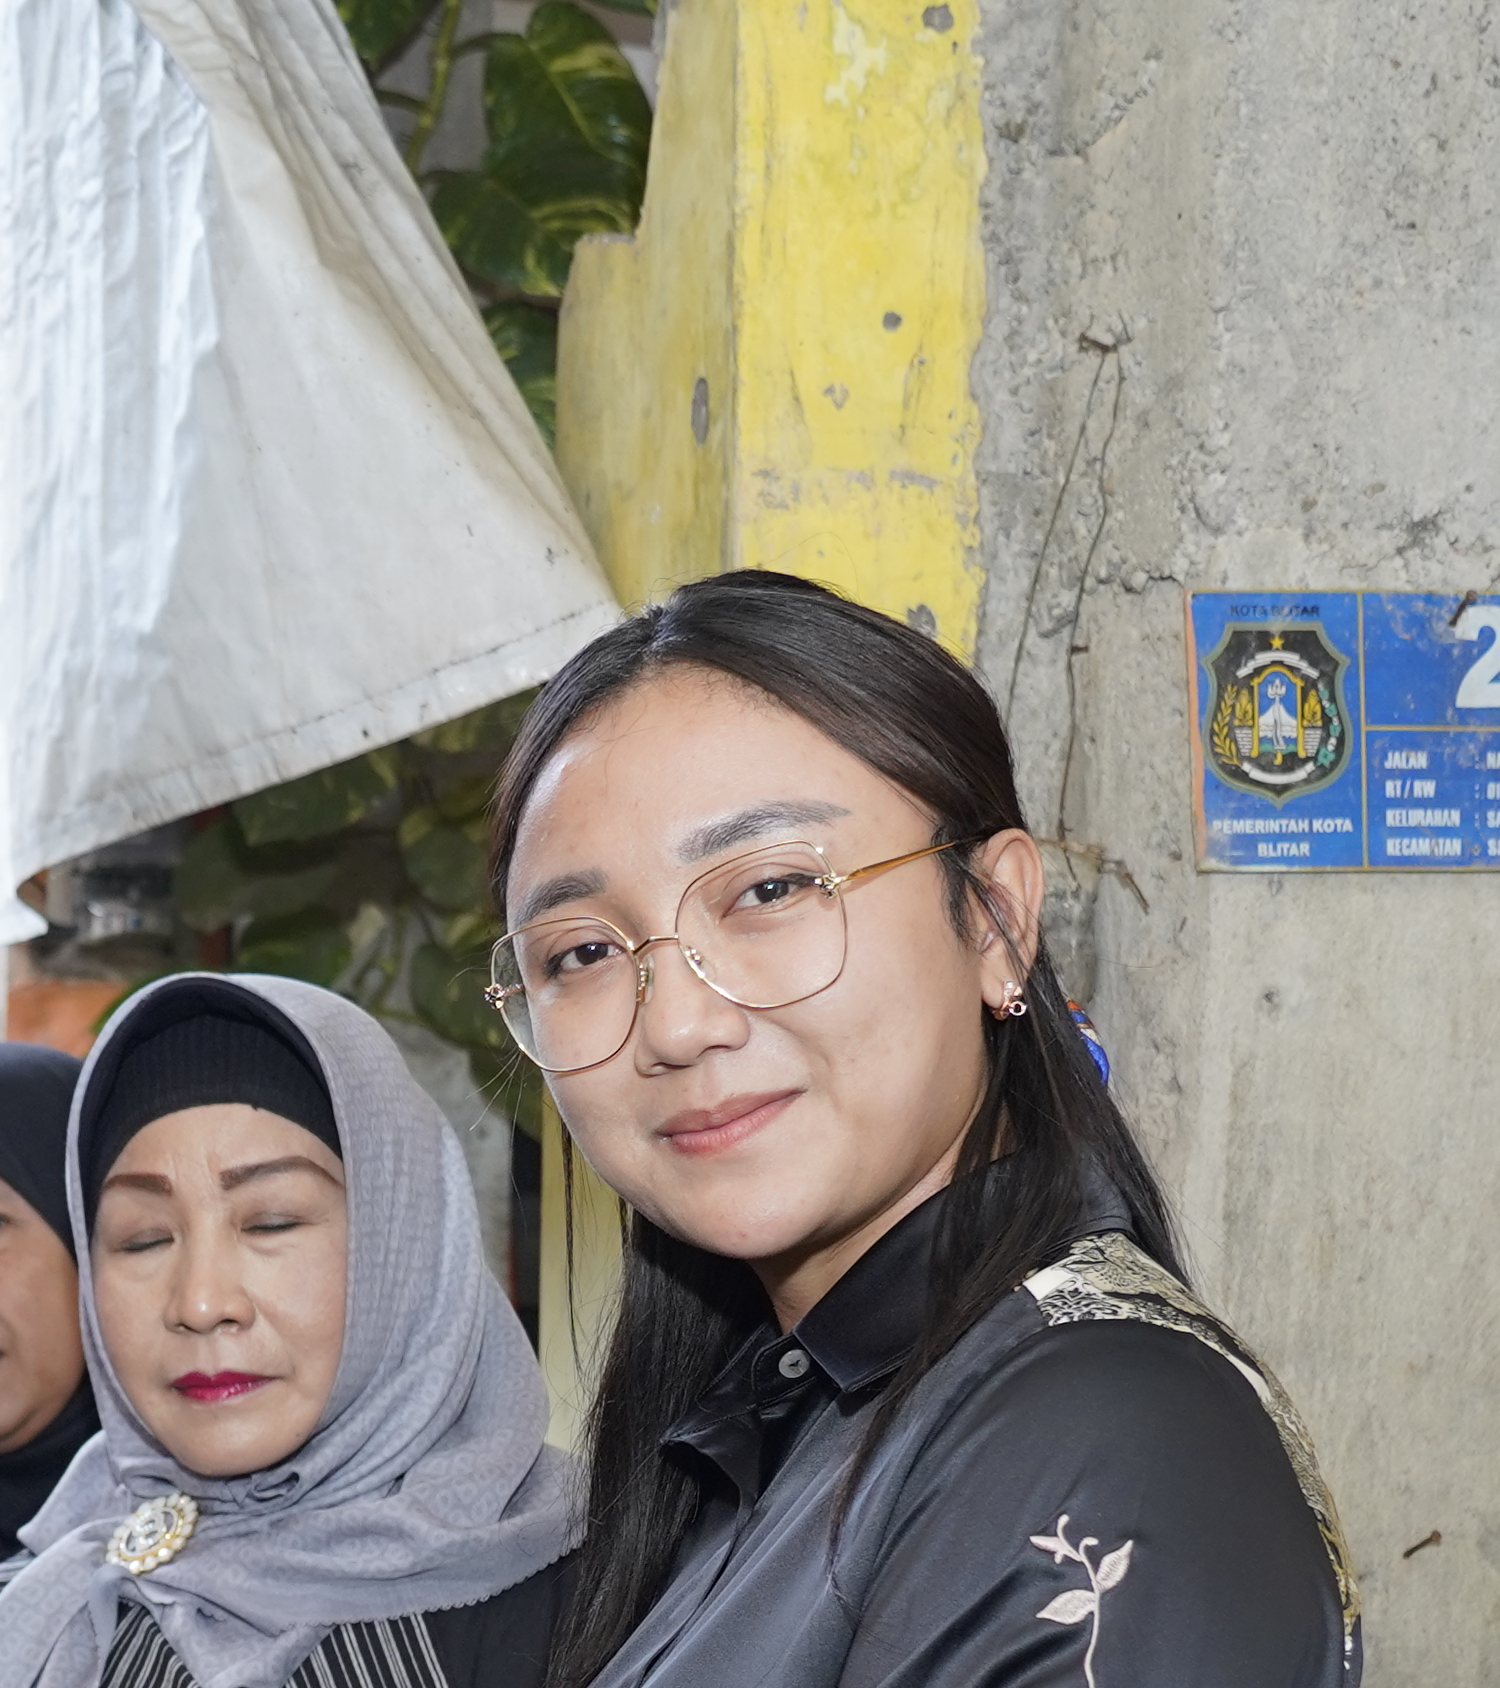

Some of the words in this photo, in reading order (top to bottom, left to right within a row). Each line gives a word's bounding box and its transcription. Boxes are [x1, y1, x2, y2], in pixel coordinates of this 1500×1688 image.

[1230, 605, 1268, 617] KOTA
[1384, 751, 1428, 770] JALAN
[1212, 819, 1309, 834] PEMERINTAH
[1312, 818, 1353, 833] KOTA
[1386, 809, 1461, 828] KELURAHAN
[1257, 842, 1310, 857] BLITAR
[1387, 838, 1462, 857] KECAMATAN
